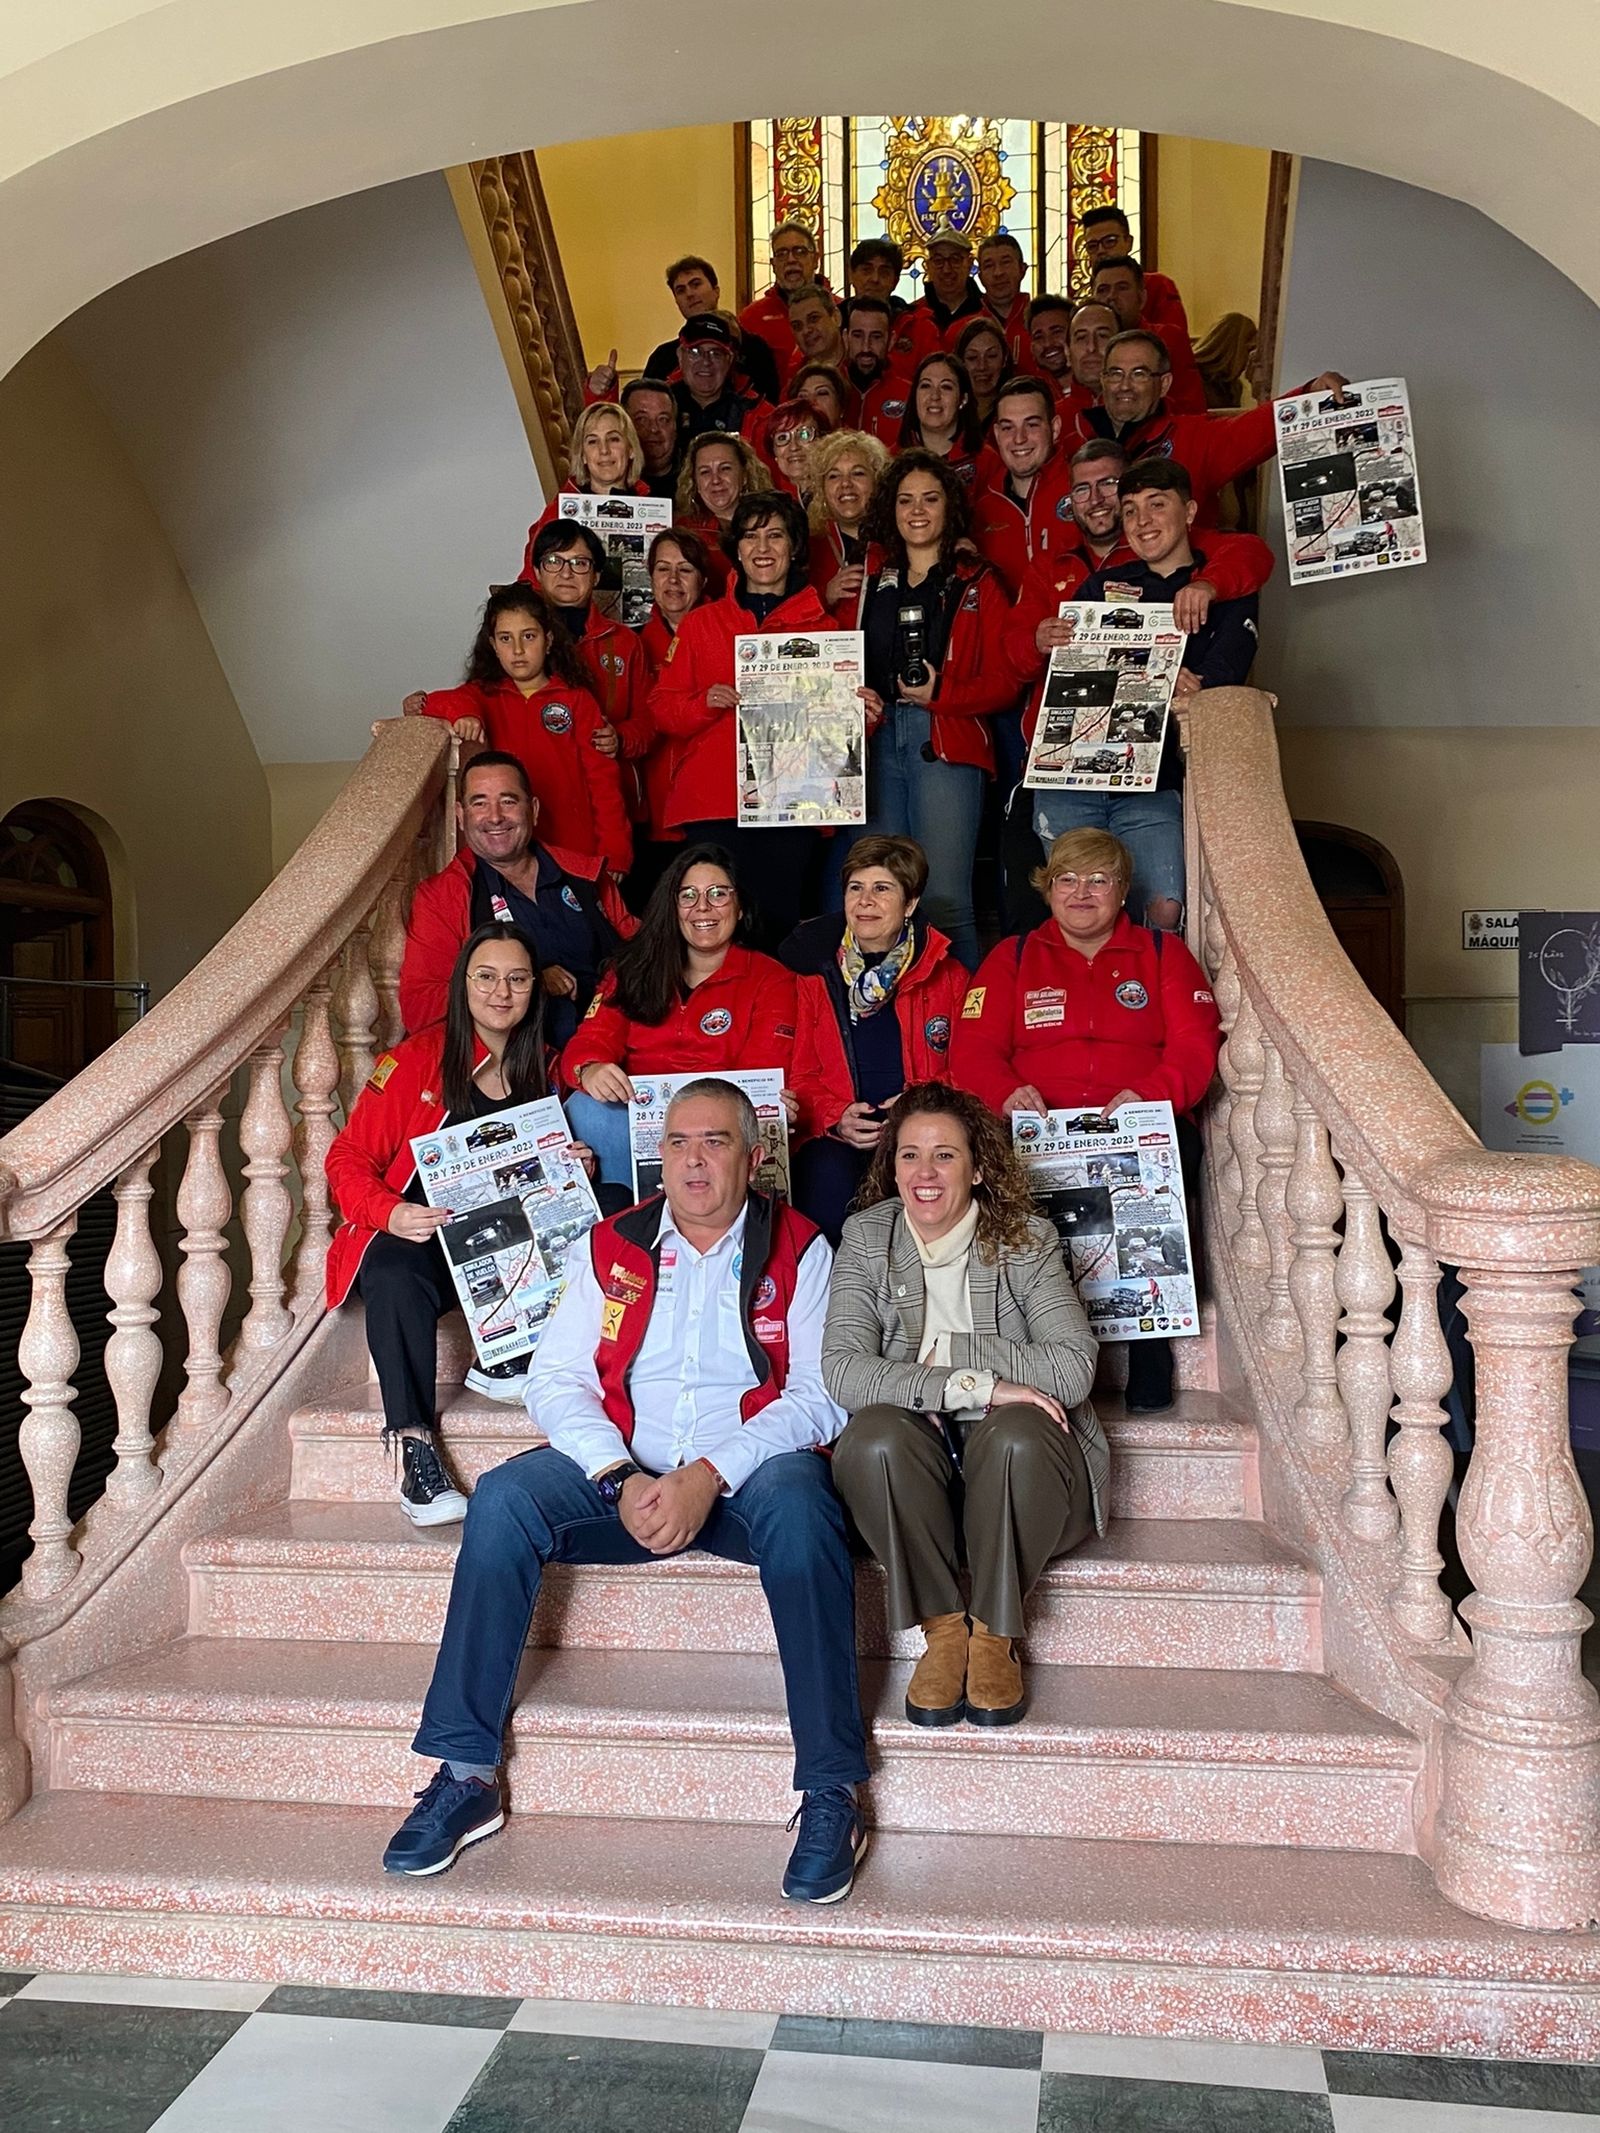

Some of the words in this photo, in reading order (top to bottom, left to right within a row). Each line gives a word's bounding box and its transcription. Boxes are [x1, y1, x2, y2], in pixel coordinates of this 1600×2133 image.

[1312, 419, 1323, 427] DE
[1090, 633, 1101, 641] DE
[1133, 633, 1152, 641] 2023
[1485, 917, 1519, 928] SALA
[636, 1111, 647, 1120] 28
[649, 1111, 655, 1120] Y
[1021, 1144, 1031, 1153] 28
[1034, 1143, 1041, 1152] Y
[1044, 1142, 1055, 1151] 29
[1058, 1140, 1071, 1149] DE
[1111, 1135, 1135, 1145] 2023
[427, 1172, 439, 1182] 28
[440, 1168, 447, 1177] Y
[450, 1164, 462, 1175] 29
[463, 1159, 477, 1170] DE
[512, 1140, 534, 1154] 2023
